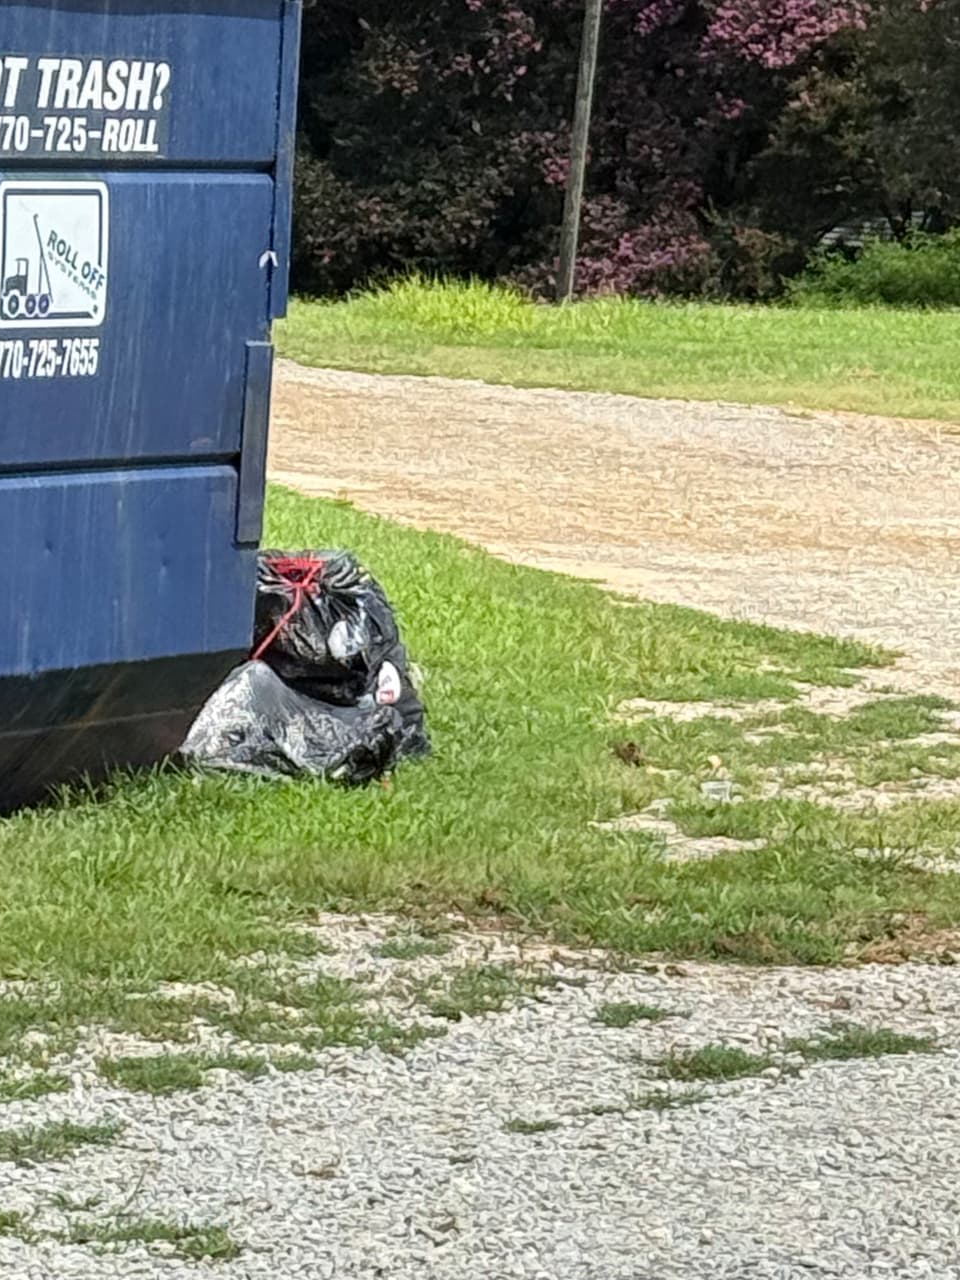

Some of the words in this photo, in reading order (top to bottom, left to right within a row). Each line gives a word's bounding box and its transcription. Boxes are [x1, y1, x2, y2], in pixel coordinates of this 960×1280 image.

[36, 58, 171, 111] TRASH?
[46, 229, 79, 270] ROLL
[81, 260, 105, 291] OFF
[47, 250, 97, 300] SYSTEMS
